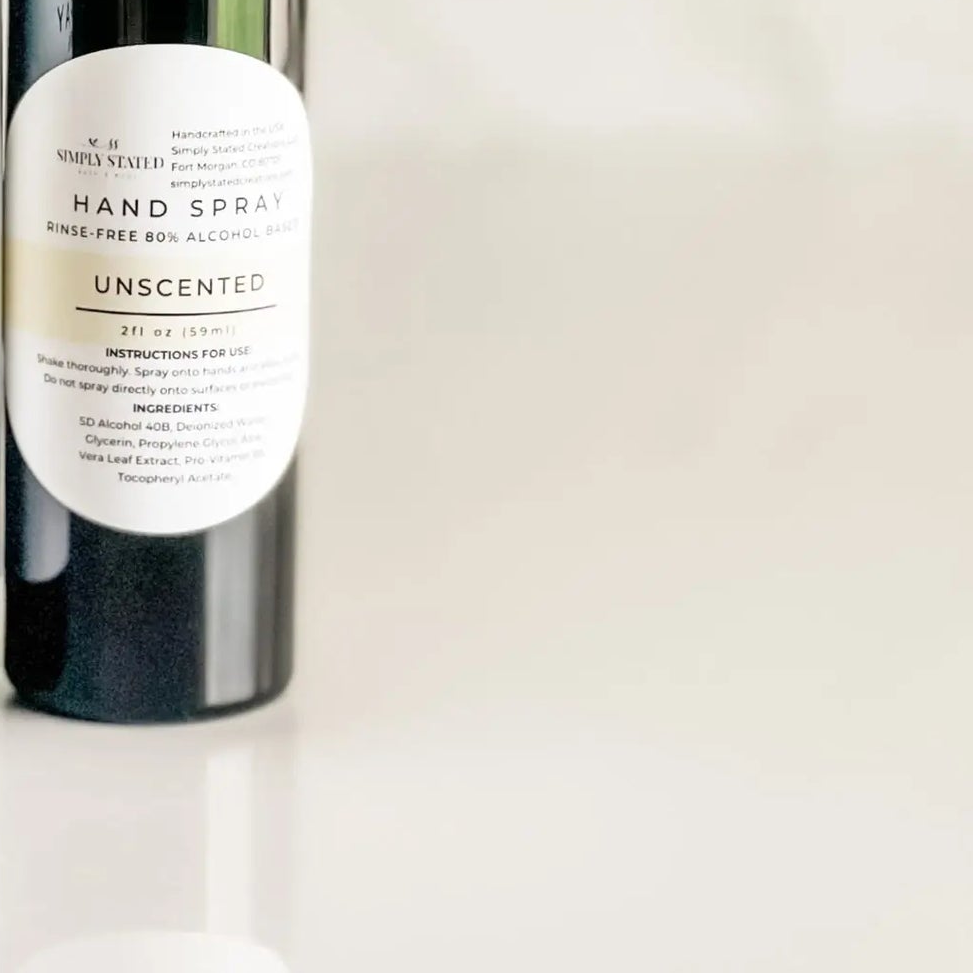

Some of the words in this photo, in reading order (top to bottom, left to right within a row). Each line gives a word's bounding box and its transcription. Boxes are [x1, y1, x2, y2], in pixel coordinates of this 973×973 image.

[171, 128, 239, 140] Handcrafted
[171, 145, 210, 157] Simply
[212, 144, 245, 155] Stated
[57, 149, 104, 168] SIMPLY
[107, 155, 165, 171] STATED
[171, 161, 195, 172] Fort
[74, 194, 168, 218] HAND
[190, 192, 284, 217] SPRAY
[46, 221, 138, 242] RINSE-FREE
[145, 231, 179, 243] 80%
[186, 228, 260, 243] ALCOHOL
[265, 217, 300, 236] BAS
[95, 273, 265, 297] UNSCENTED
[121, 326, 144, 337] 2fl
[154, 328, 173, 337] oz
[106, 347, 198, 360] INSTRUCTIONS
[202, 346, 226, 359] FOR
[134, 366, 169, 380] Spray
[172, 365, 200, 377] onto
[43, 373, 58, 384] Do
[59, 376, 77, 388] not
[78, 379, 109, 394] spray
[112, 383, 156, 397] directly
[160, 385, 188, 396] onto
[133, 402, 220, 414] INGREDIENTS:
[78, 416, 95, 427] SD
[98, 417, 142, 431] Alcohol
[177, 418, 234, 433] Deionized
[85, 434, 136, 449] Glycerin,
[139, 437, 199, 452] Propylene
[78, 450, 104, 463] Vera
[107, 454, 132, 465] Leaf
[118, 471, 184, 486] Tocopheryl
